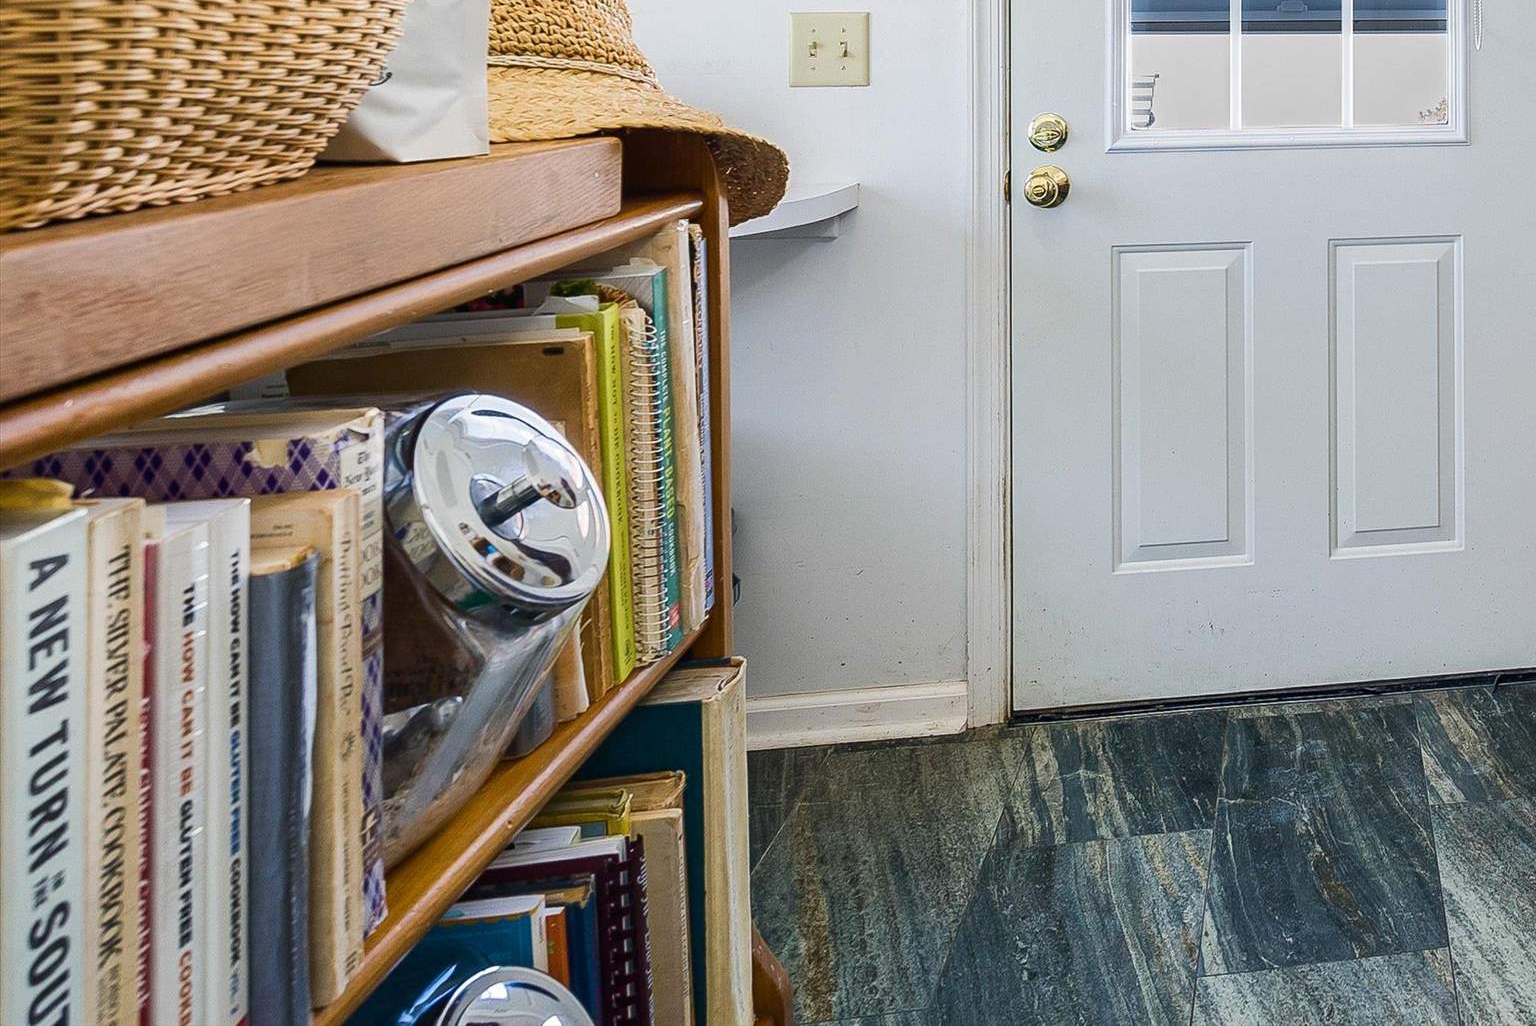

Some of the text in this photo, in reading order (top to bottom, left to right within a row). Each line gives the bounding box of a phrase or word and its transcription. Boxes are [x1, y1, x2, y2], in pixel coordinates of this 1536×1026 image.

[615, 453, 623, 523] COOKBOOK
[663, 407, 676, 519] PLANT-BASED
[107, 544, 131, 601] THE
[230, 551, 241, 585] THE
[182, 584, 196, 626] THE
[230, 587, 241, 634] HOW
[105, 608, 131, 700] SILVER
[181, 630, 194, 683] HOW
[230, 637, 241, 678] CAN
[28, 554, 70, 873] A NEW TURN
[181, 688, 194, 737] CAN
[230, 679, 241, 698] IT
[230, 701, 241, 726] BE
[103, 699, 129, 799] PALATE
[181, 739, 193, 759] IT
[230, 729, 241, 805] GLUTEN
[180, 765, 193, 796] BE
[179, 799, 193, 888] GLUTEN
[230, 806, 241, 857] FREE
[98, 805, 128, 971] COOKBOOK
[230, 858, 241, 967] COOKBOOK
[179, 888, 193, 950] FREE
